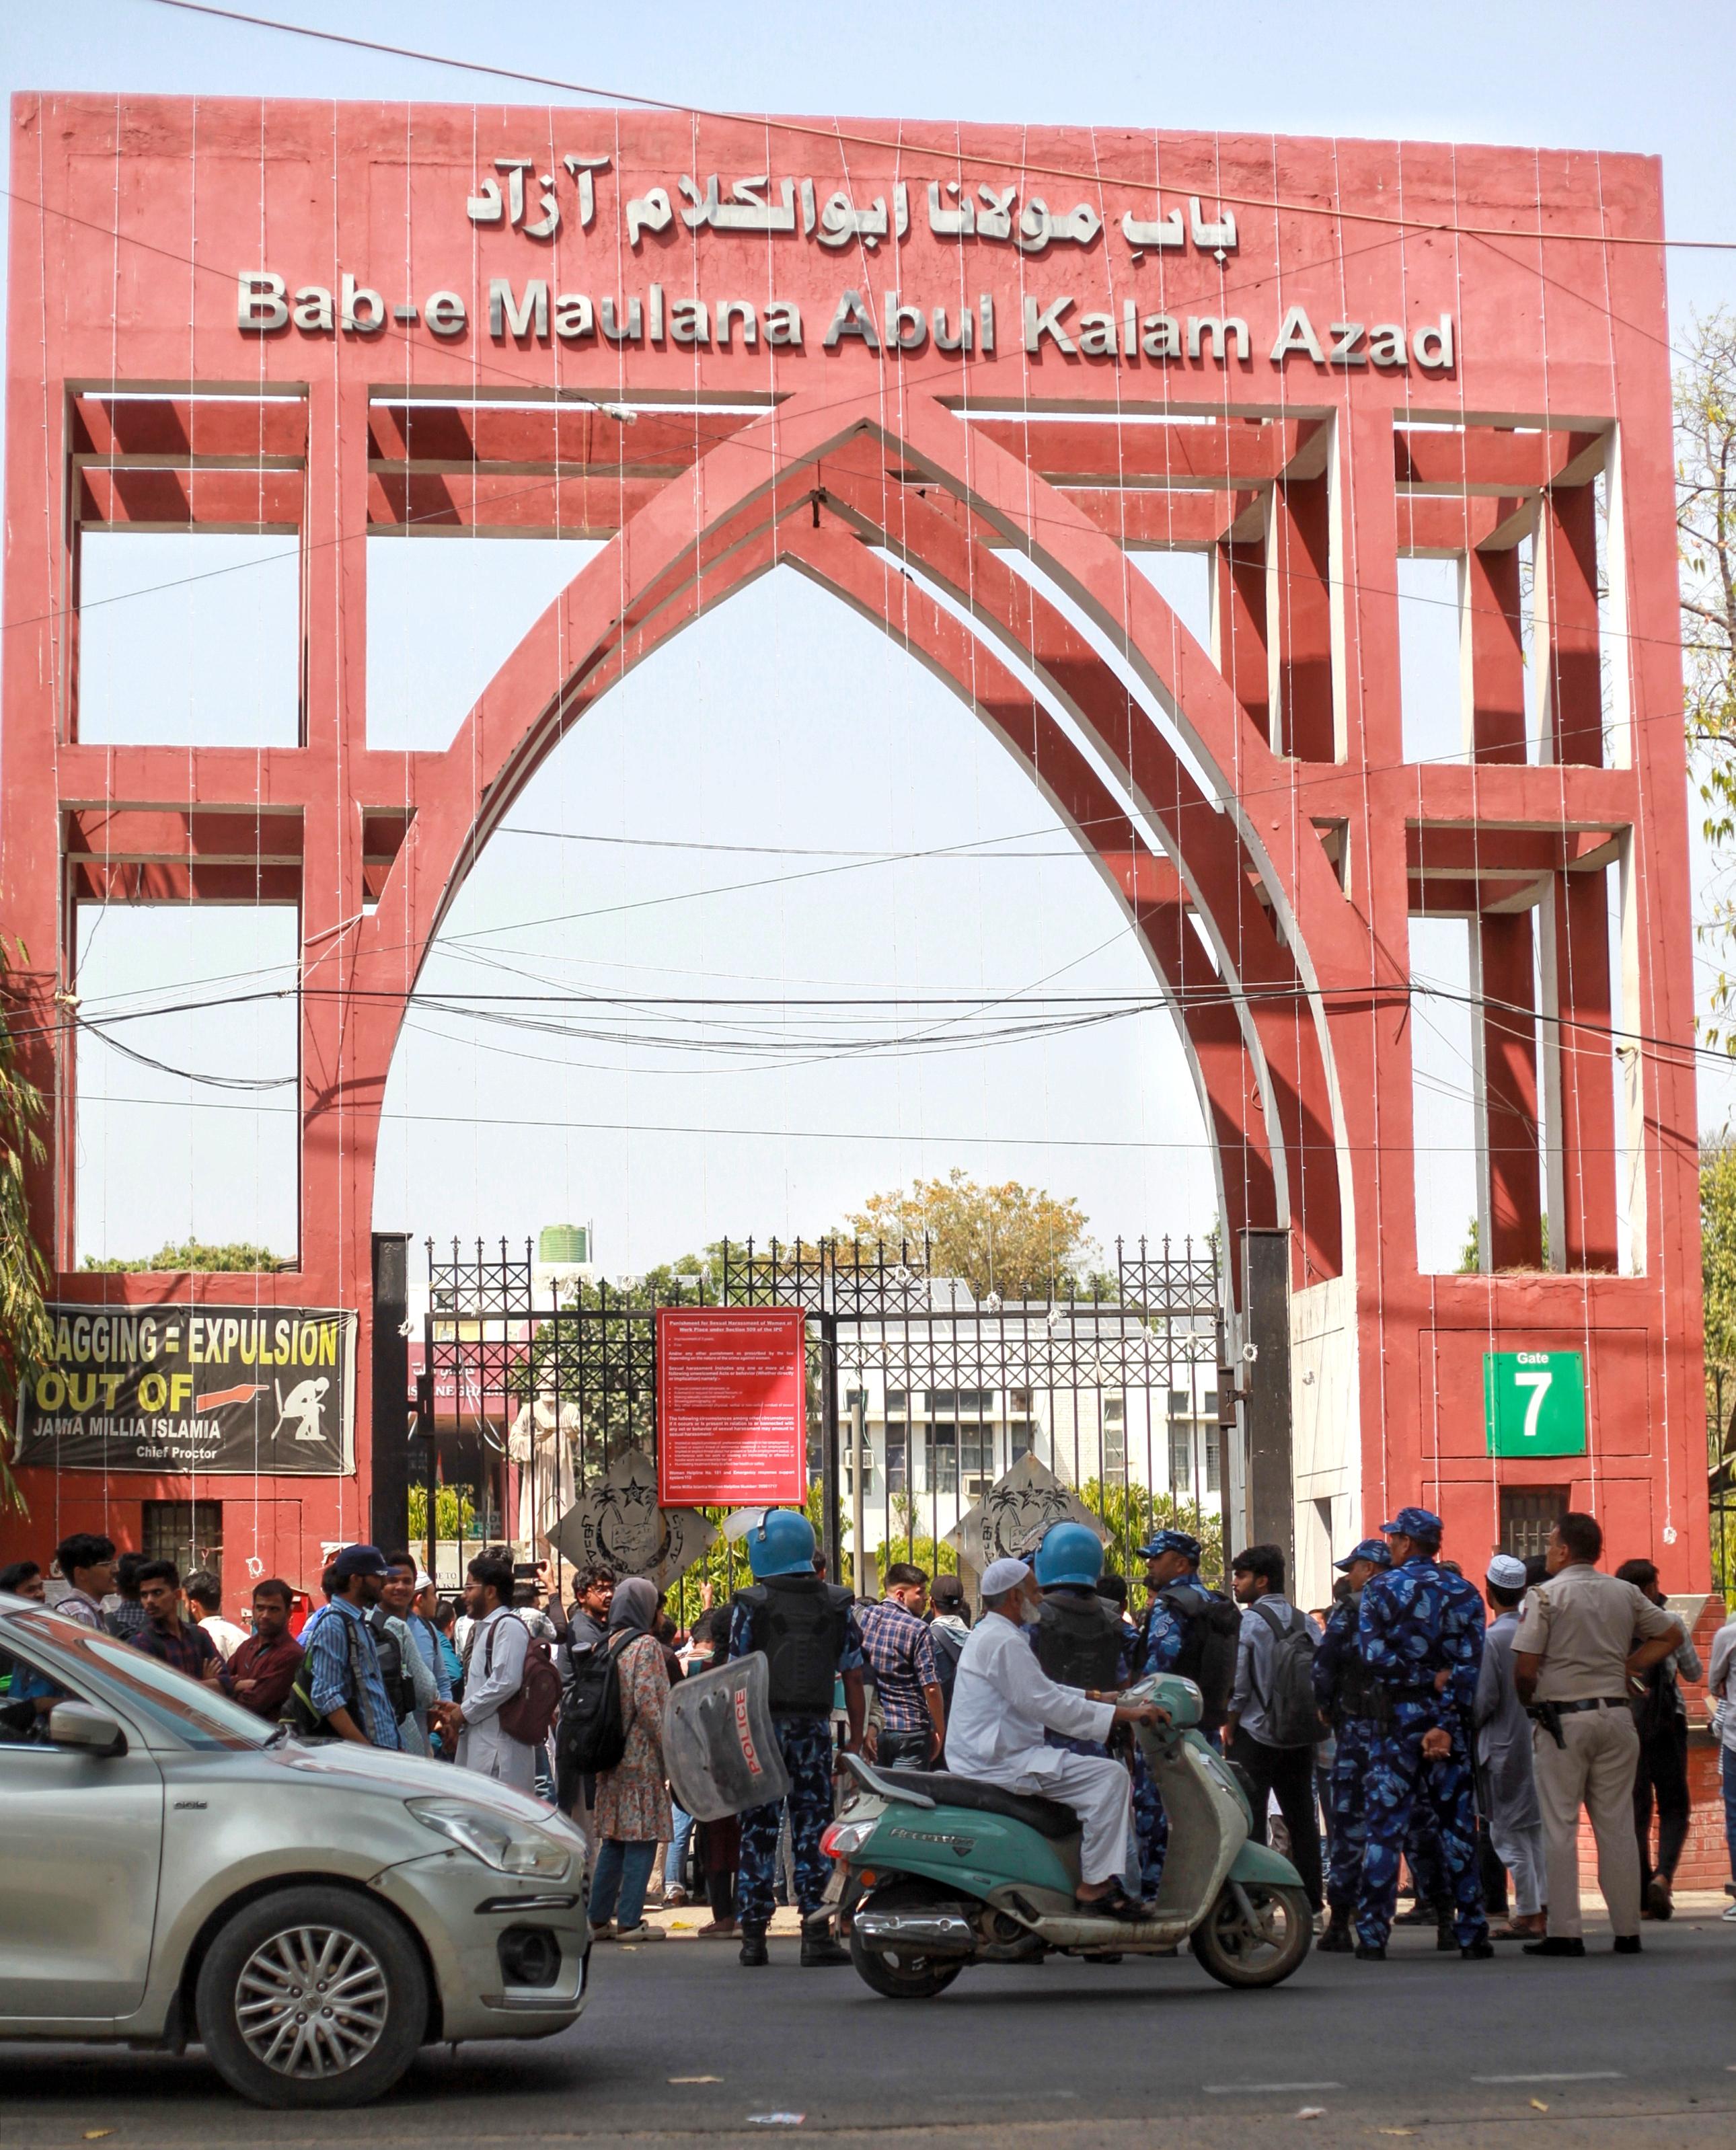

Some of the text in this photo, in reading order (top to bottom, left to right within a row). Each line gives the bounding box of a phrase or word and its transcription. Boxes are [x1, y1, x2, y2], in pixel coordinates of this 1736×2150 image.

[927, 180, 1102, 252] مولانا
[237, 272, 1454, 370] Bab-e Maulana Abul Kalam Azad
[188, 1318, 337, 1366] EXPULSION
[1517, 1352, 1549, 1364] Gate
[36, 1371, 194, 1412] OUT OF
[1515, 1372, 1552, 1436] 7
[33, 1417, 221, 1439] JAMIA MILLIA ISLAMIA
[137, 1446, 217, 1459] Chief Proctor
[736, 1689, 761, 1774] POLICE
